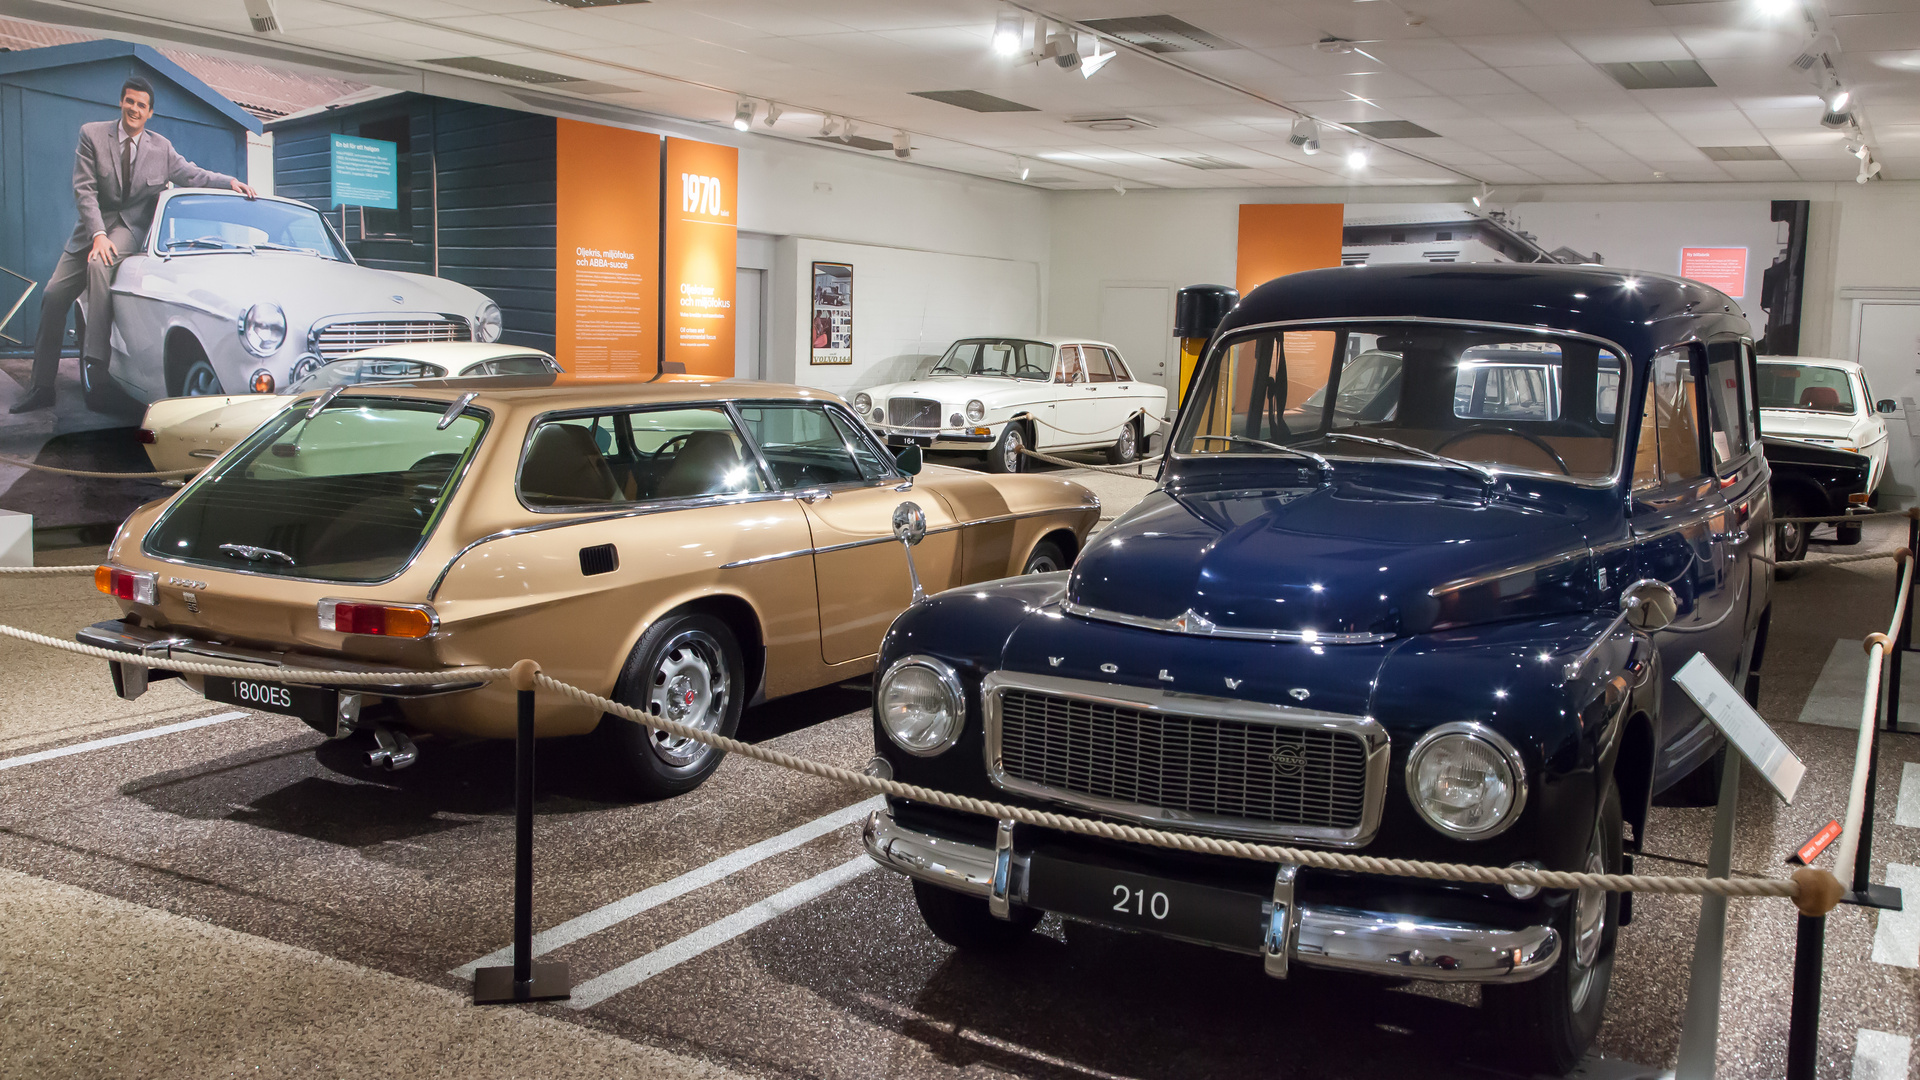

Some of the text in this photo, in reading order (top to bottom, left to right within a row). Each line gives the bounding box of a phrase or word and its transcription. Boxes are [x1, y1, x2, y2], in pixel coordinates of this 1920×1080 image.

[682, 173, 720, 216] 1970
[576, 247, 634, 260] Oljekris, miljöfokus
[576, 258, 628, 269] och ABBA-succé
[680, 296, 730, 309] och miljöfokus
[1048, 656, 1311, 701] VOLVO
[232, 680, 291, 707] 1800ES
[1271, 755, 1305, 765] VOLVO
[1113, 885, 1169, 919] 210
